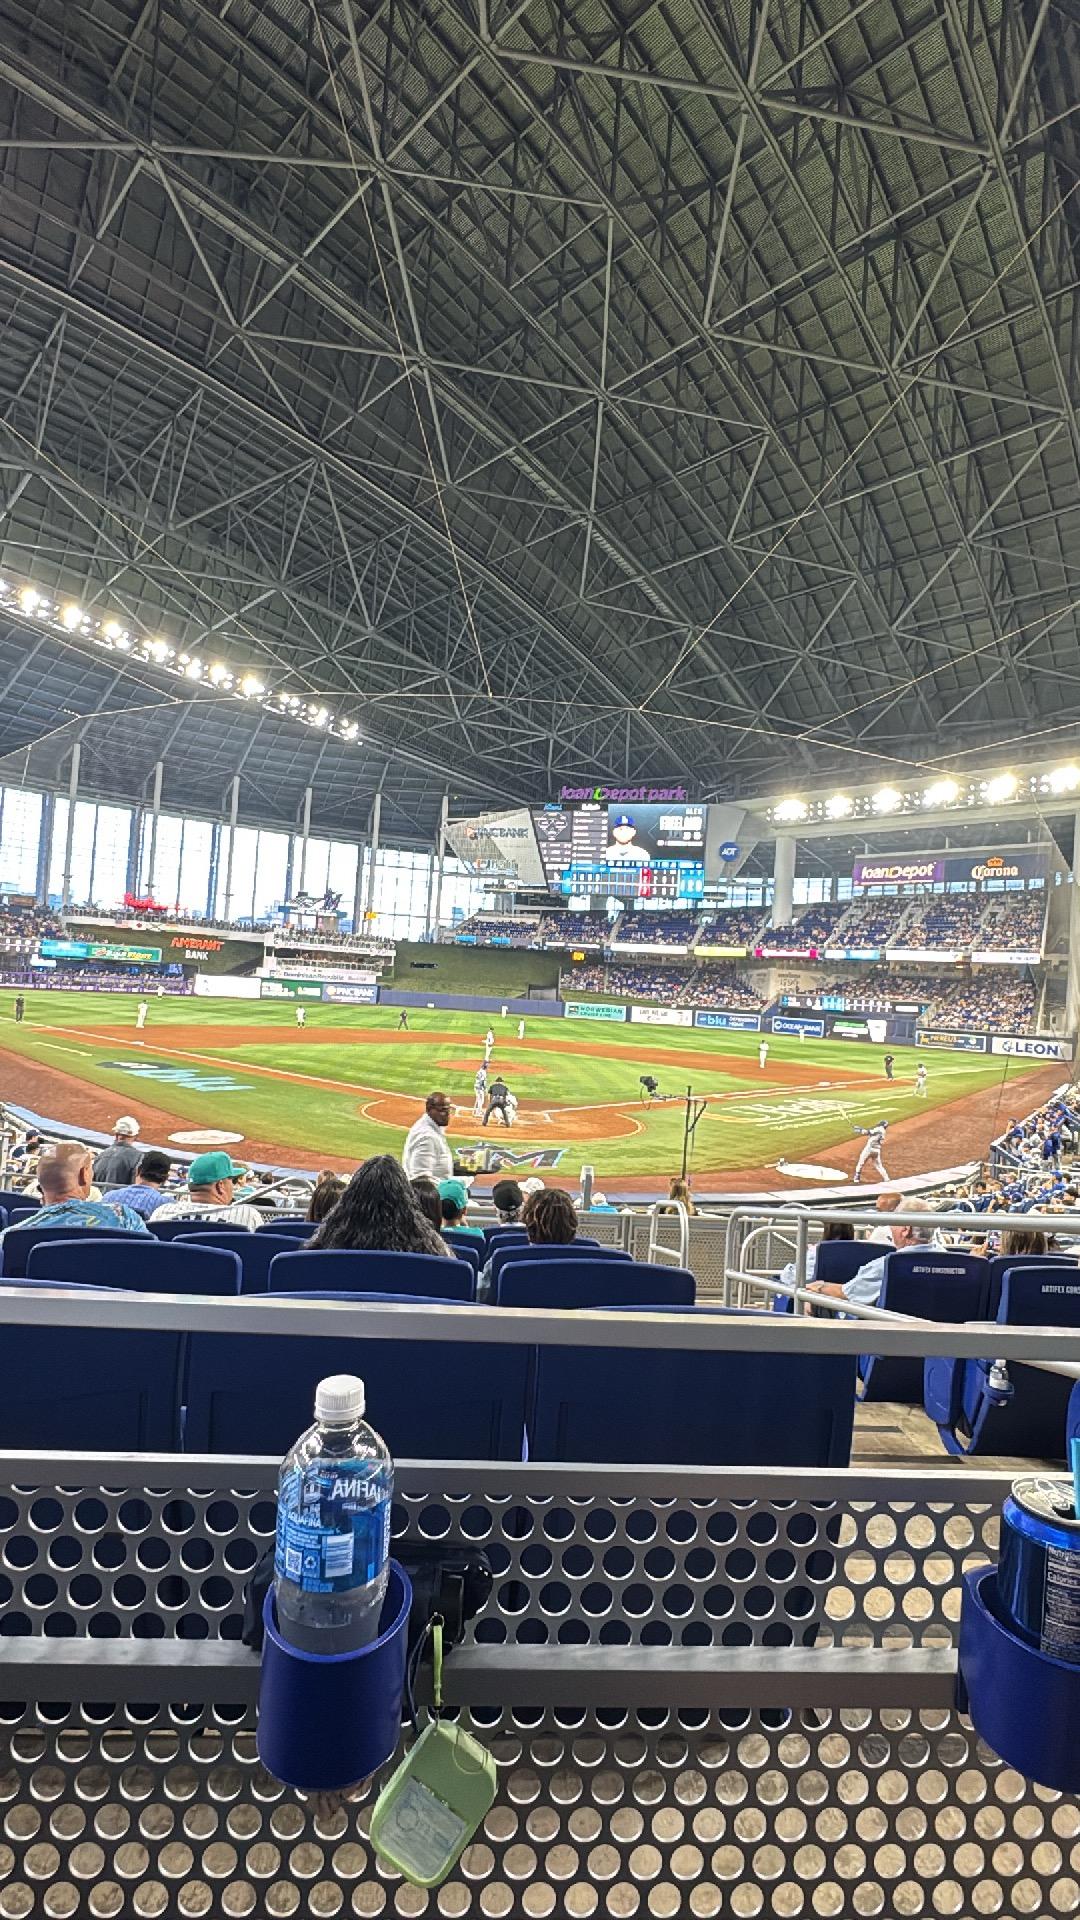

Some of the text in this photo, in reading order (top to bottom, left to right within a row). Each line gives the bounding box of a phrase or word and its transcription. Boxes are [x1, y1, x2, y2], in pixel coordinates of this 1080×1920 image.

[647, 786, 687, 801] park
[861, 863, 935, 880] loanDepot
[971, 865, 1018, 880] Corona
[185, 949, 209, 960] BANK
[580, 1006, 623, 1014] NORWEGIAN
[1015, 1042, 1059, 1056] LEON
[1041, 1284, 1065, 1294] ARTIFEX
